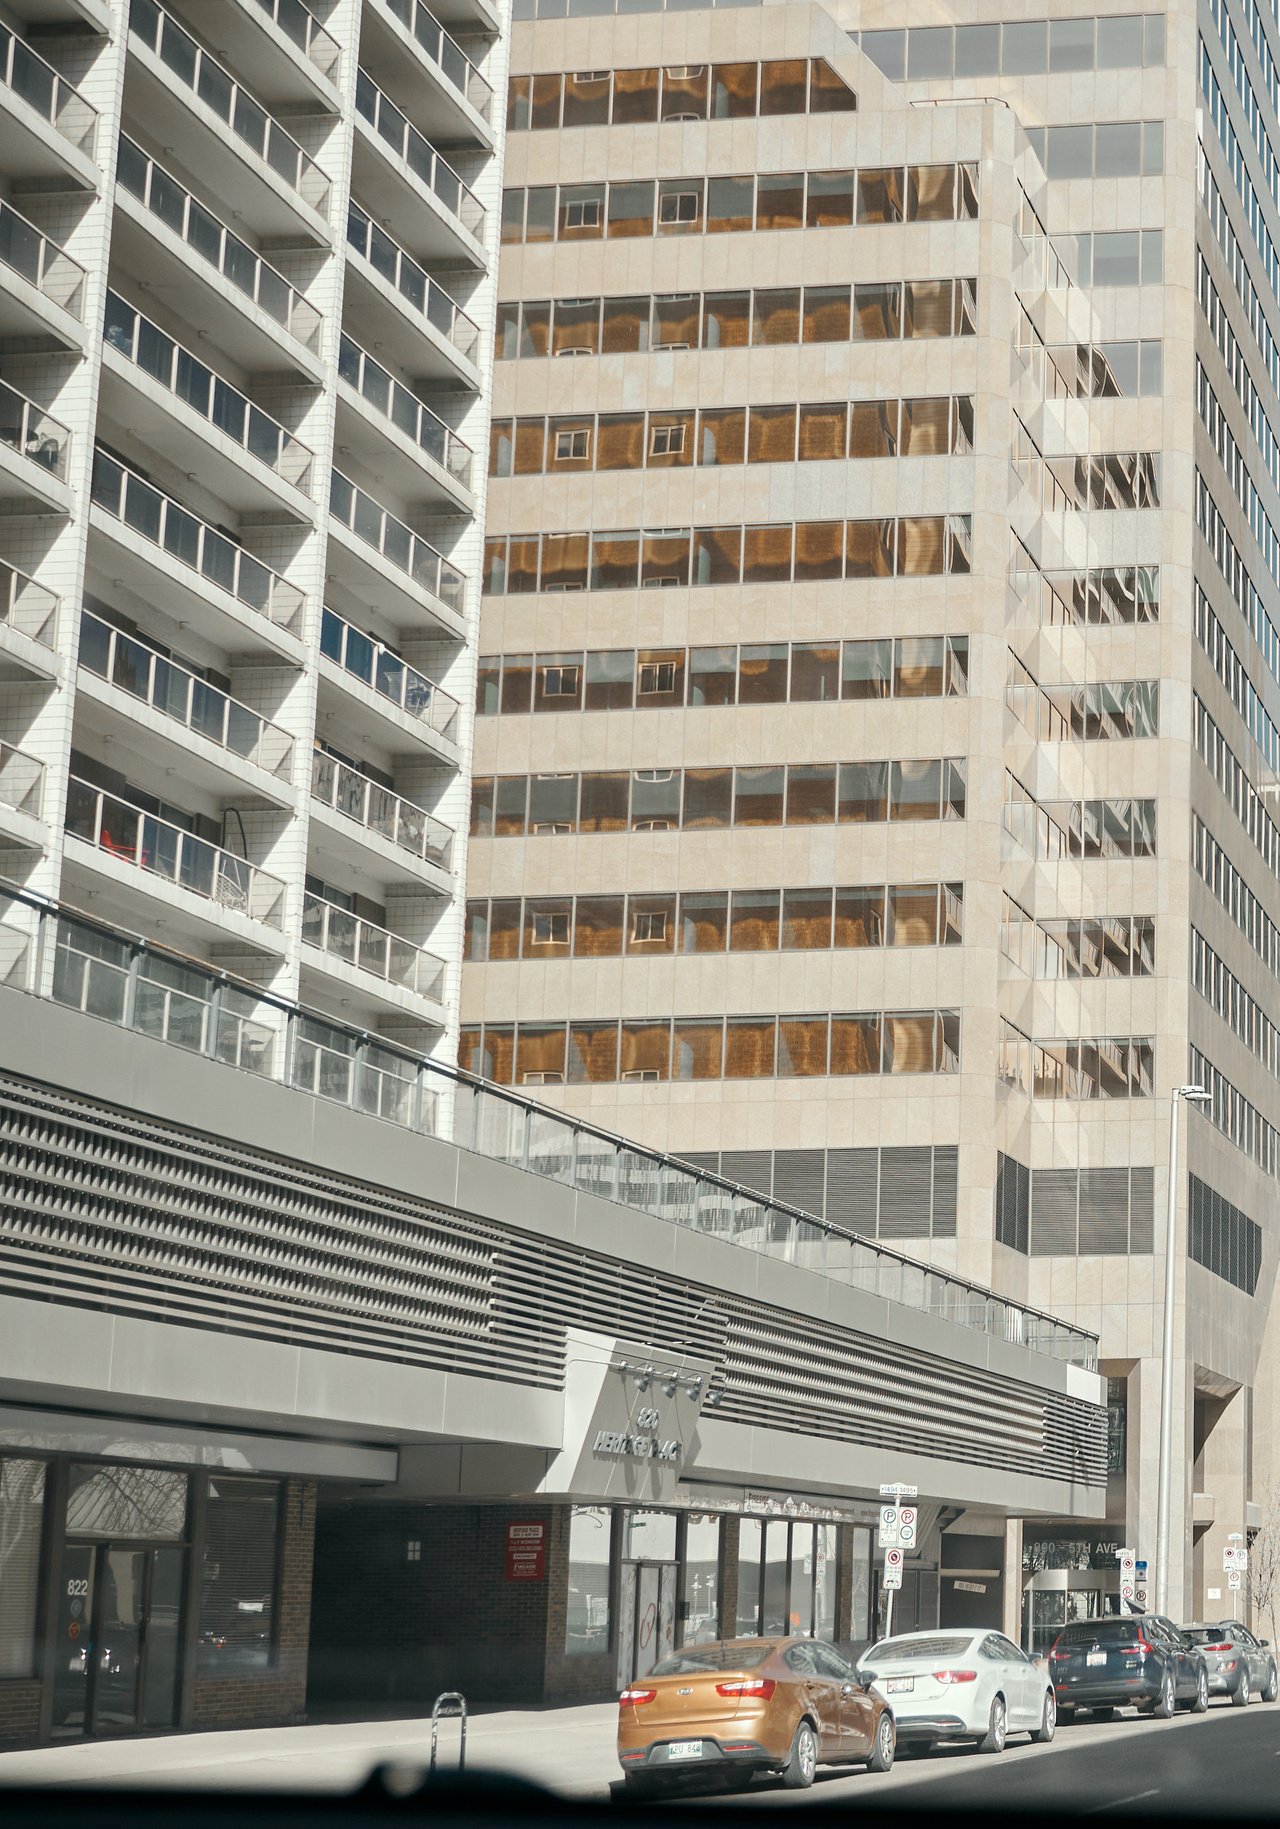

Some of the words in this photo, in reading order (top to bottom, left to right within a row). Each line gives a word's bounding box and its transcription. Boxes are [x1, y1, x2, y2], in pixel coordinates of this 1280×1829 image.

[1068, 1542, 1091, 1554] 5TH
[1095, 1542, 1118, 1554] AVE
[67, 1579, 88, 1596] 822
[670, 1744, 684, 1754] KPU
